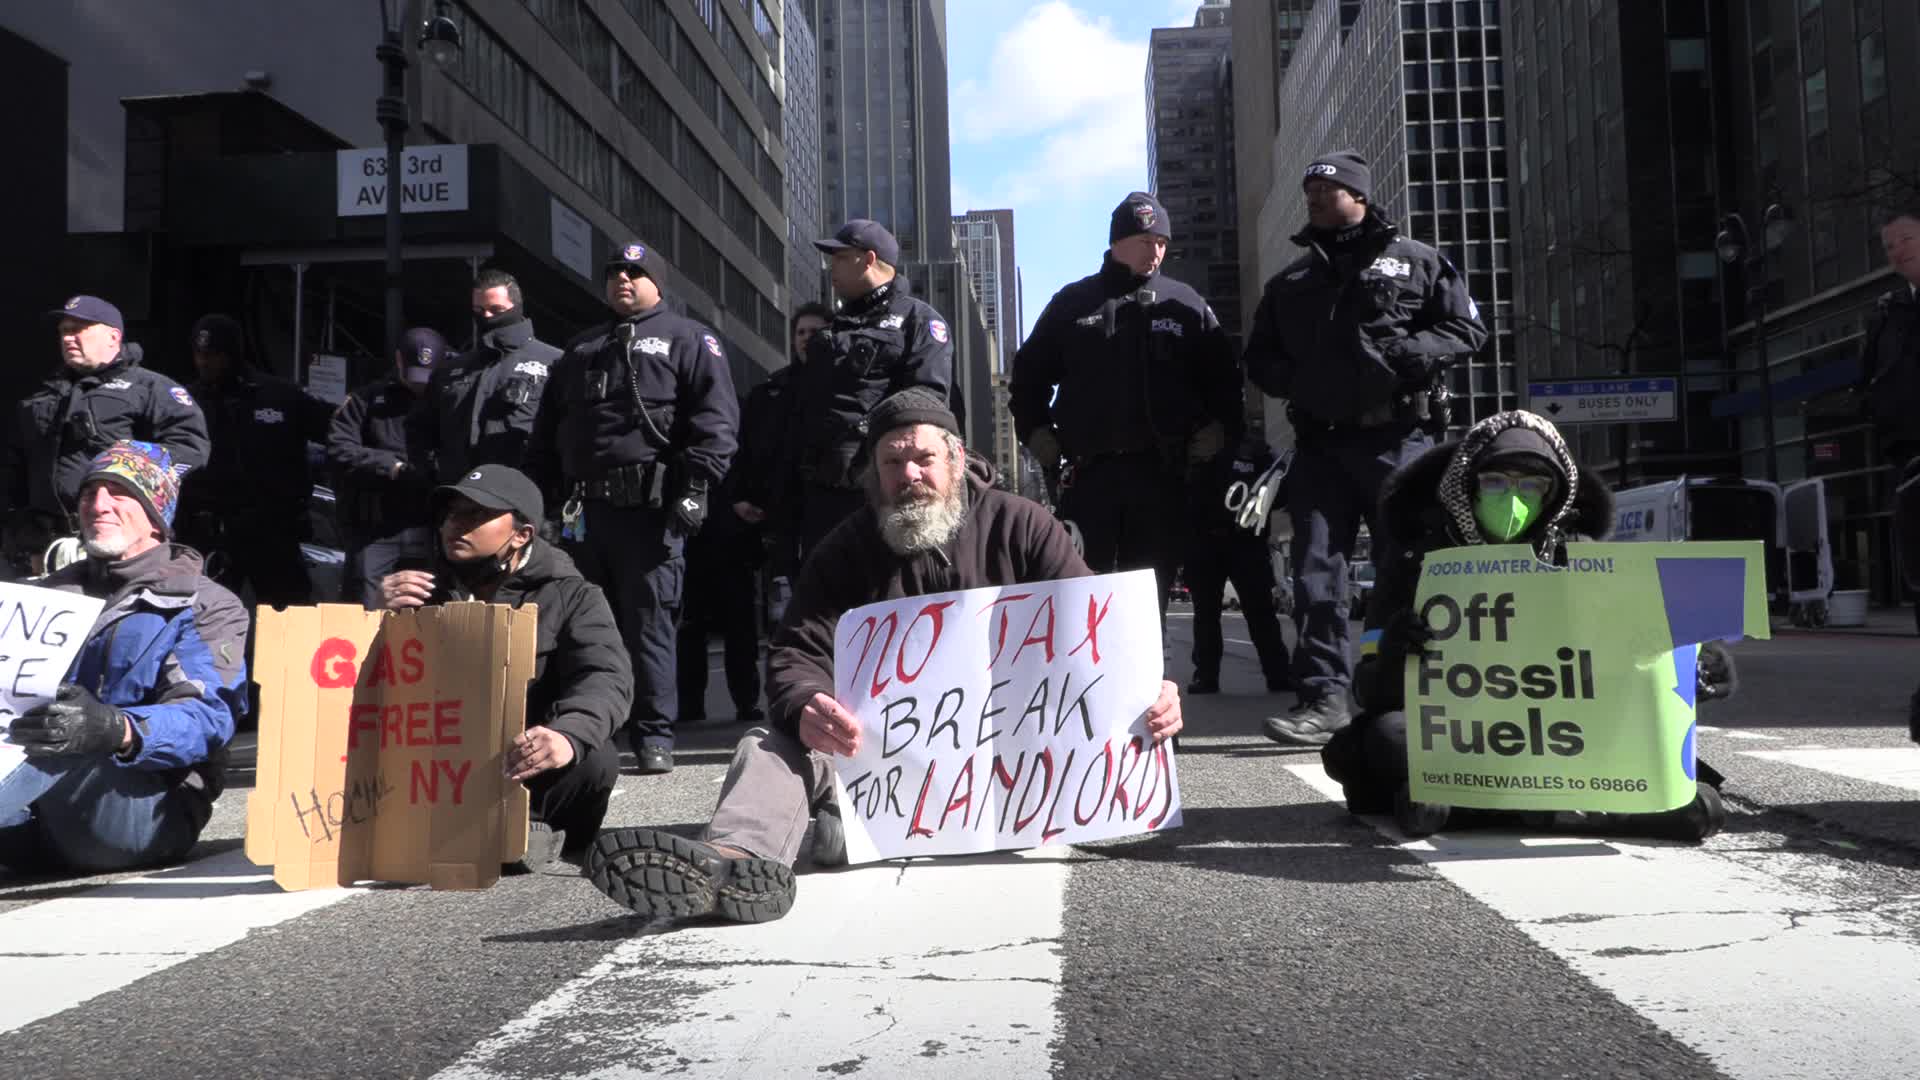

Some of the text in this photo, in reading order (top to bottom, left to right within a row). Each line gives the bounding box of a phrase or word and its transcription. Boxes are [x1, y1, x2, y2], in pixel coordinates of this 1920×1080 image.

[408, 154, 442, 175] 3rd
[356, 182, 449, 206] AVNUE
[1578, 395, 1659, 408] BUSES ONLY
[1617, 511, 1642, 530] ICE
[1464, 561, 1474, 574] &
[1477, 559, 1531, 573] WATER
[0, 600, 77, 648] NG
[1420, 592, 1515, 642] Off
[310, 636, 425, 689] GAS
[846, 591, 1113, 699] NO TAX
[1418, 646, 1595, 700] Fossil
[348, 699, 464, 750] FREE
[880, 672, 1105, 759] BREAK
[1419, 707, 1585, 756] Fuels
[410, 759, 472, 805] NY
[846, 764, 906, 821] FOR
[1422, 771, 1648, 793] text RENEWABLES to 69866
